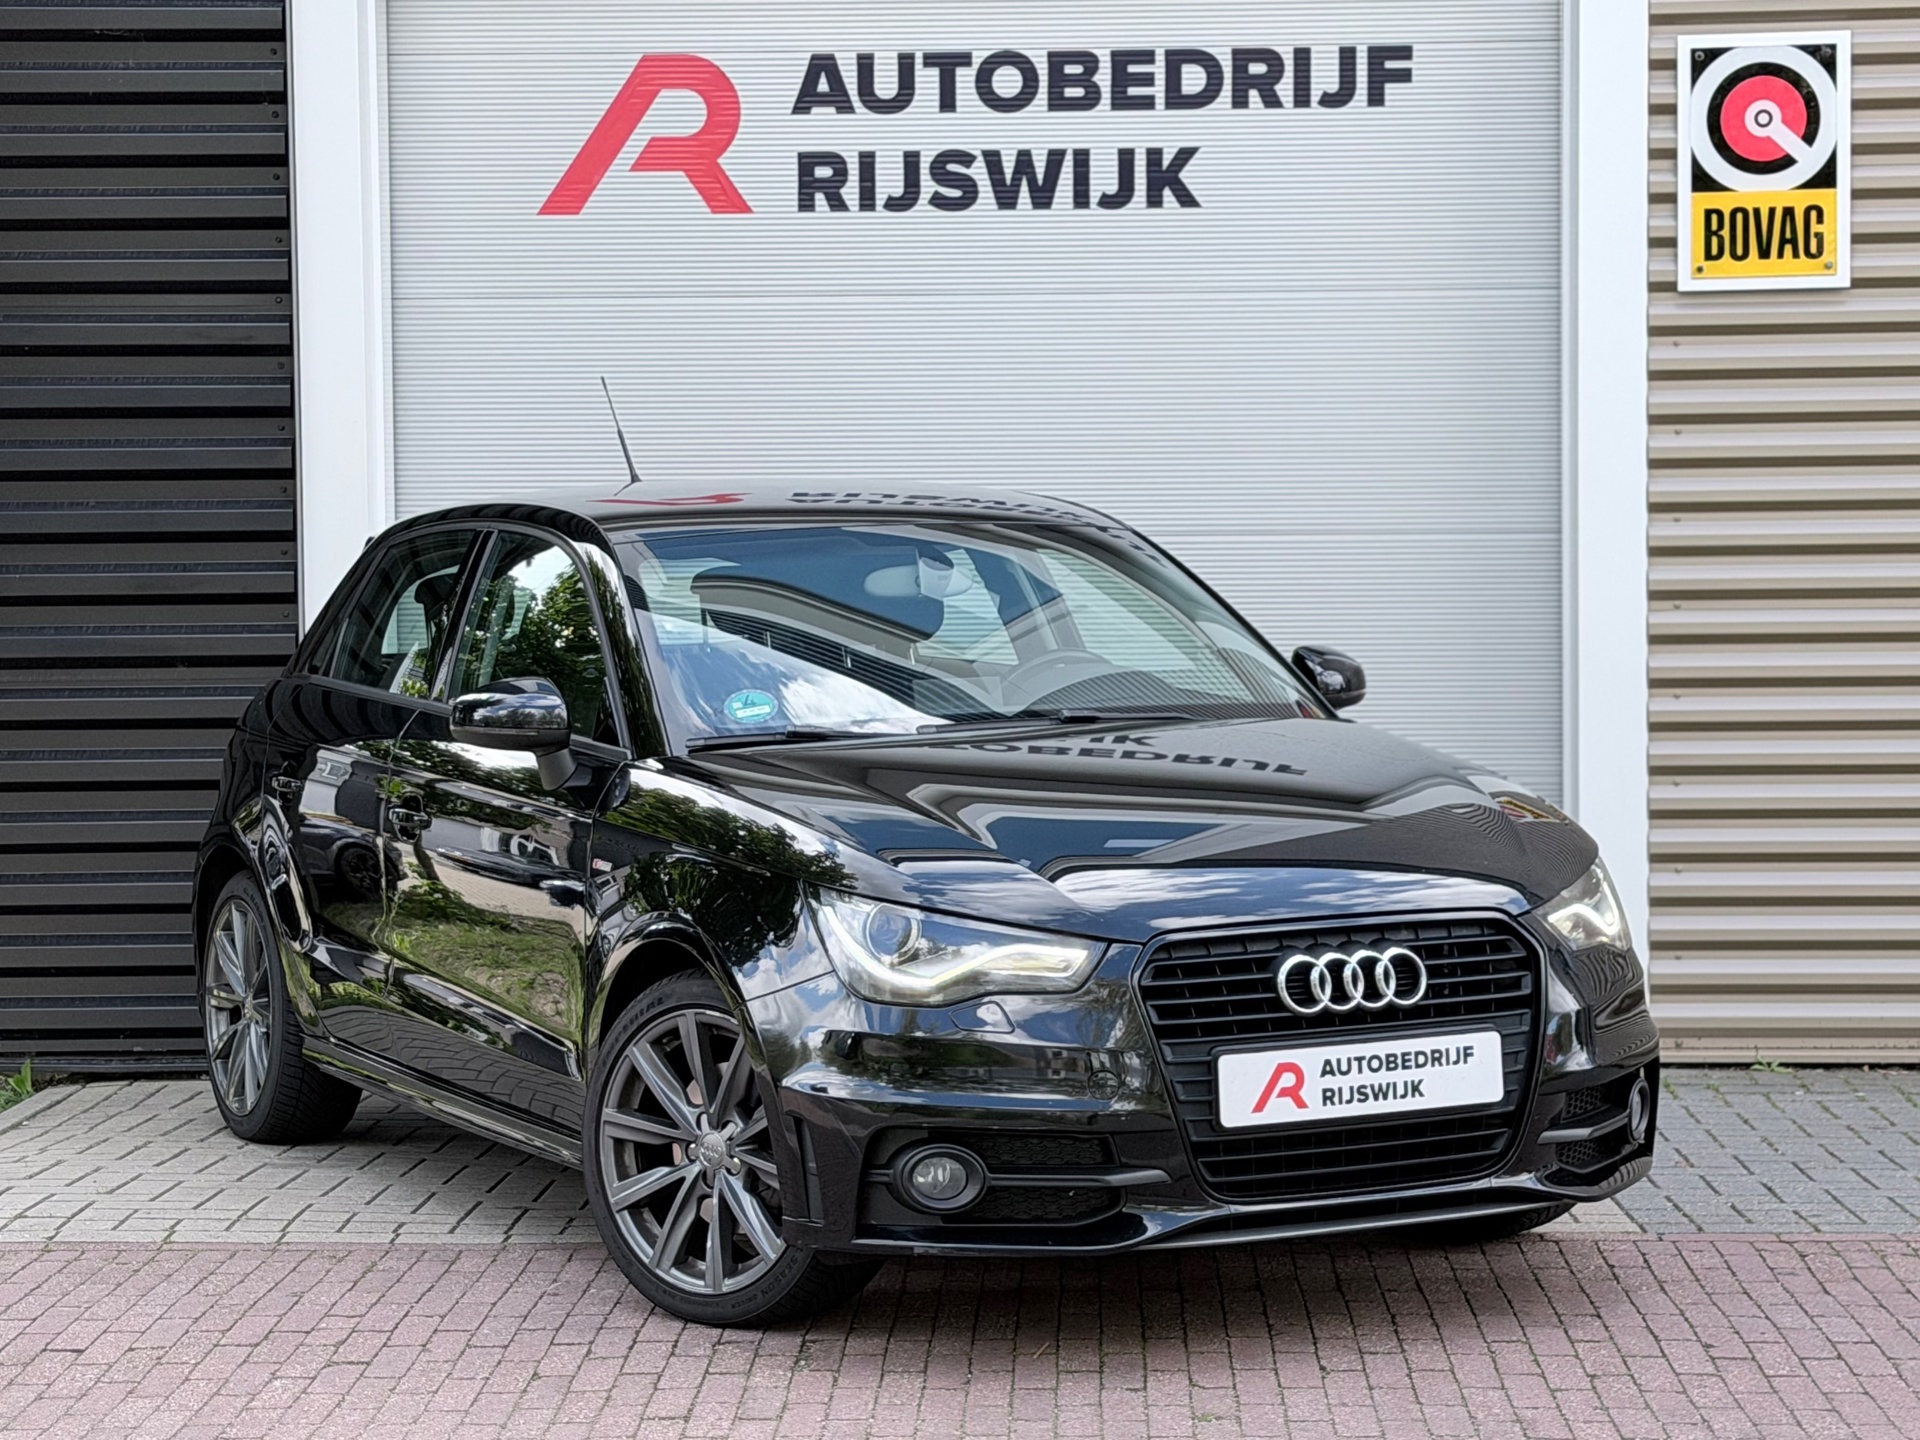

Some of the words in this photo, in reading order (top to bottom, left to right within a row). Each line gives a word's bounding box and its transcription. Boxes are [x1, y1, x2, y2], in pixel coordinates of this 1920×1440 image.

[791, 45, 1413, 115] AUTOBEDRIJF
[797, 146, 1201, 213] RIJSWIJK
[1704, 204, 1824, 261] BOVAG
[1320, 1045, 1475, 1078] AUTOBEDRIJF
[1321, 1078, 1426, 1107] RIJSWIJK
